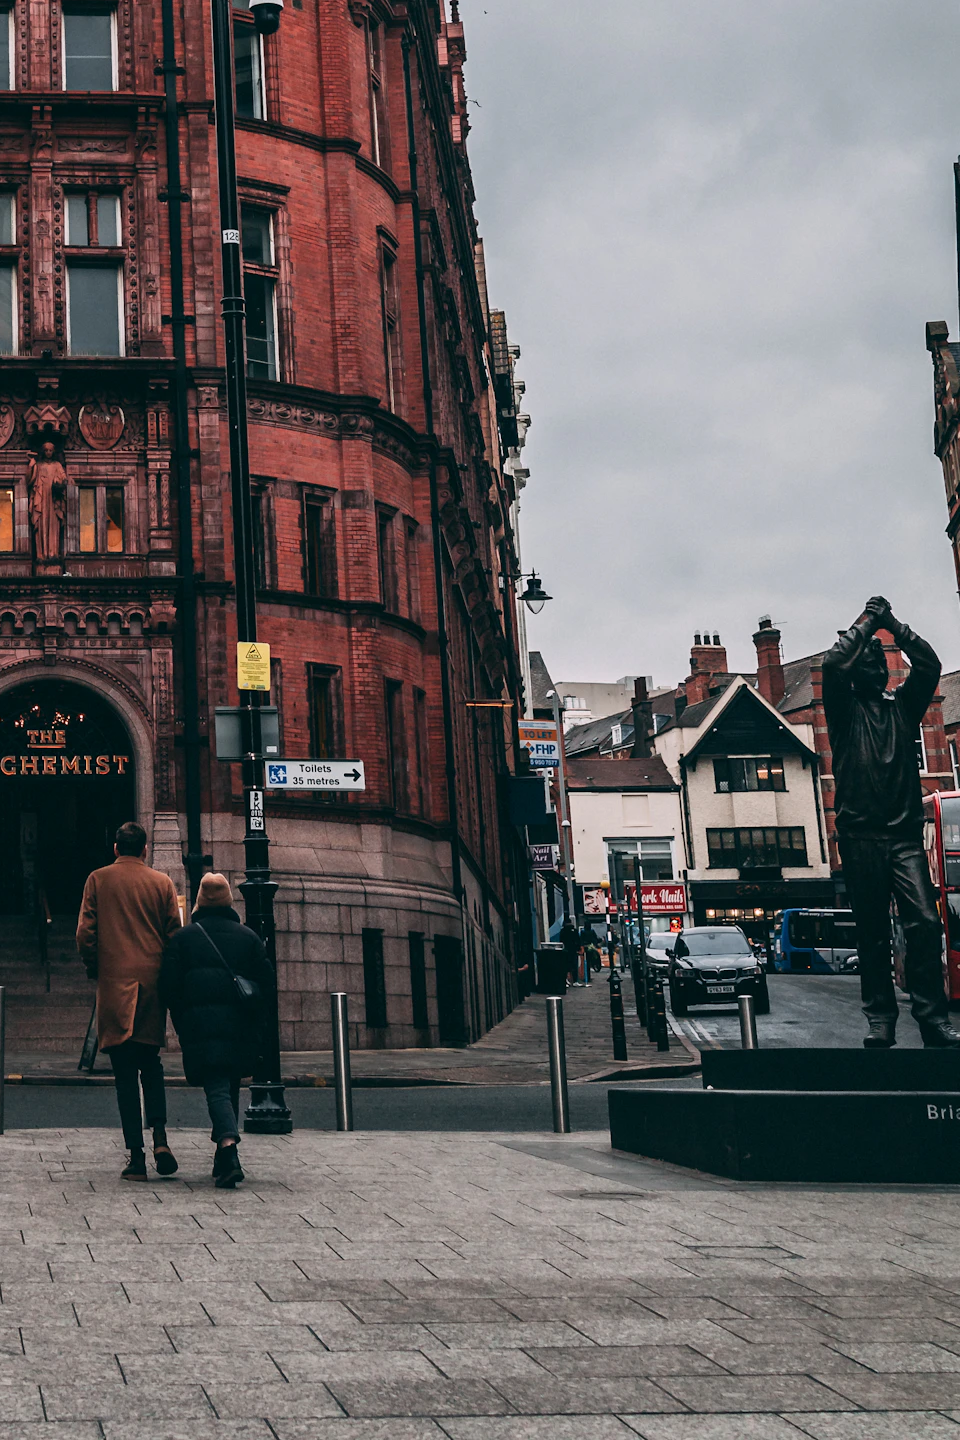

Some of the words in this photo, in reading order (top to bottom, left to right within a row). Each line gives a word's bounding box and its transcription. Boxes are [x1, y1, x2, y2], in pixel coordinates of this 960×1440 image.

[26, 729, 67, 744] THE
[523, 730, 535, 738] TO
[537, 731, 553, 739] LET
[535, 744, 556, 755] FHP
[299, 764, 332, 773] Toilets
[292, 776, 304, 785] 35
[306, 777, 340, 786] metres
[532, 846, 550, 854] Nail
[534, 854, 548, 862] Art
[659, 888, 684, 904] Nails
